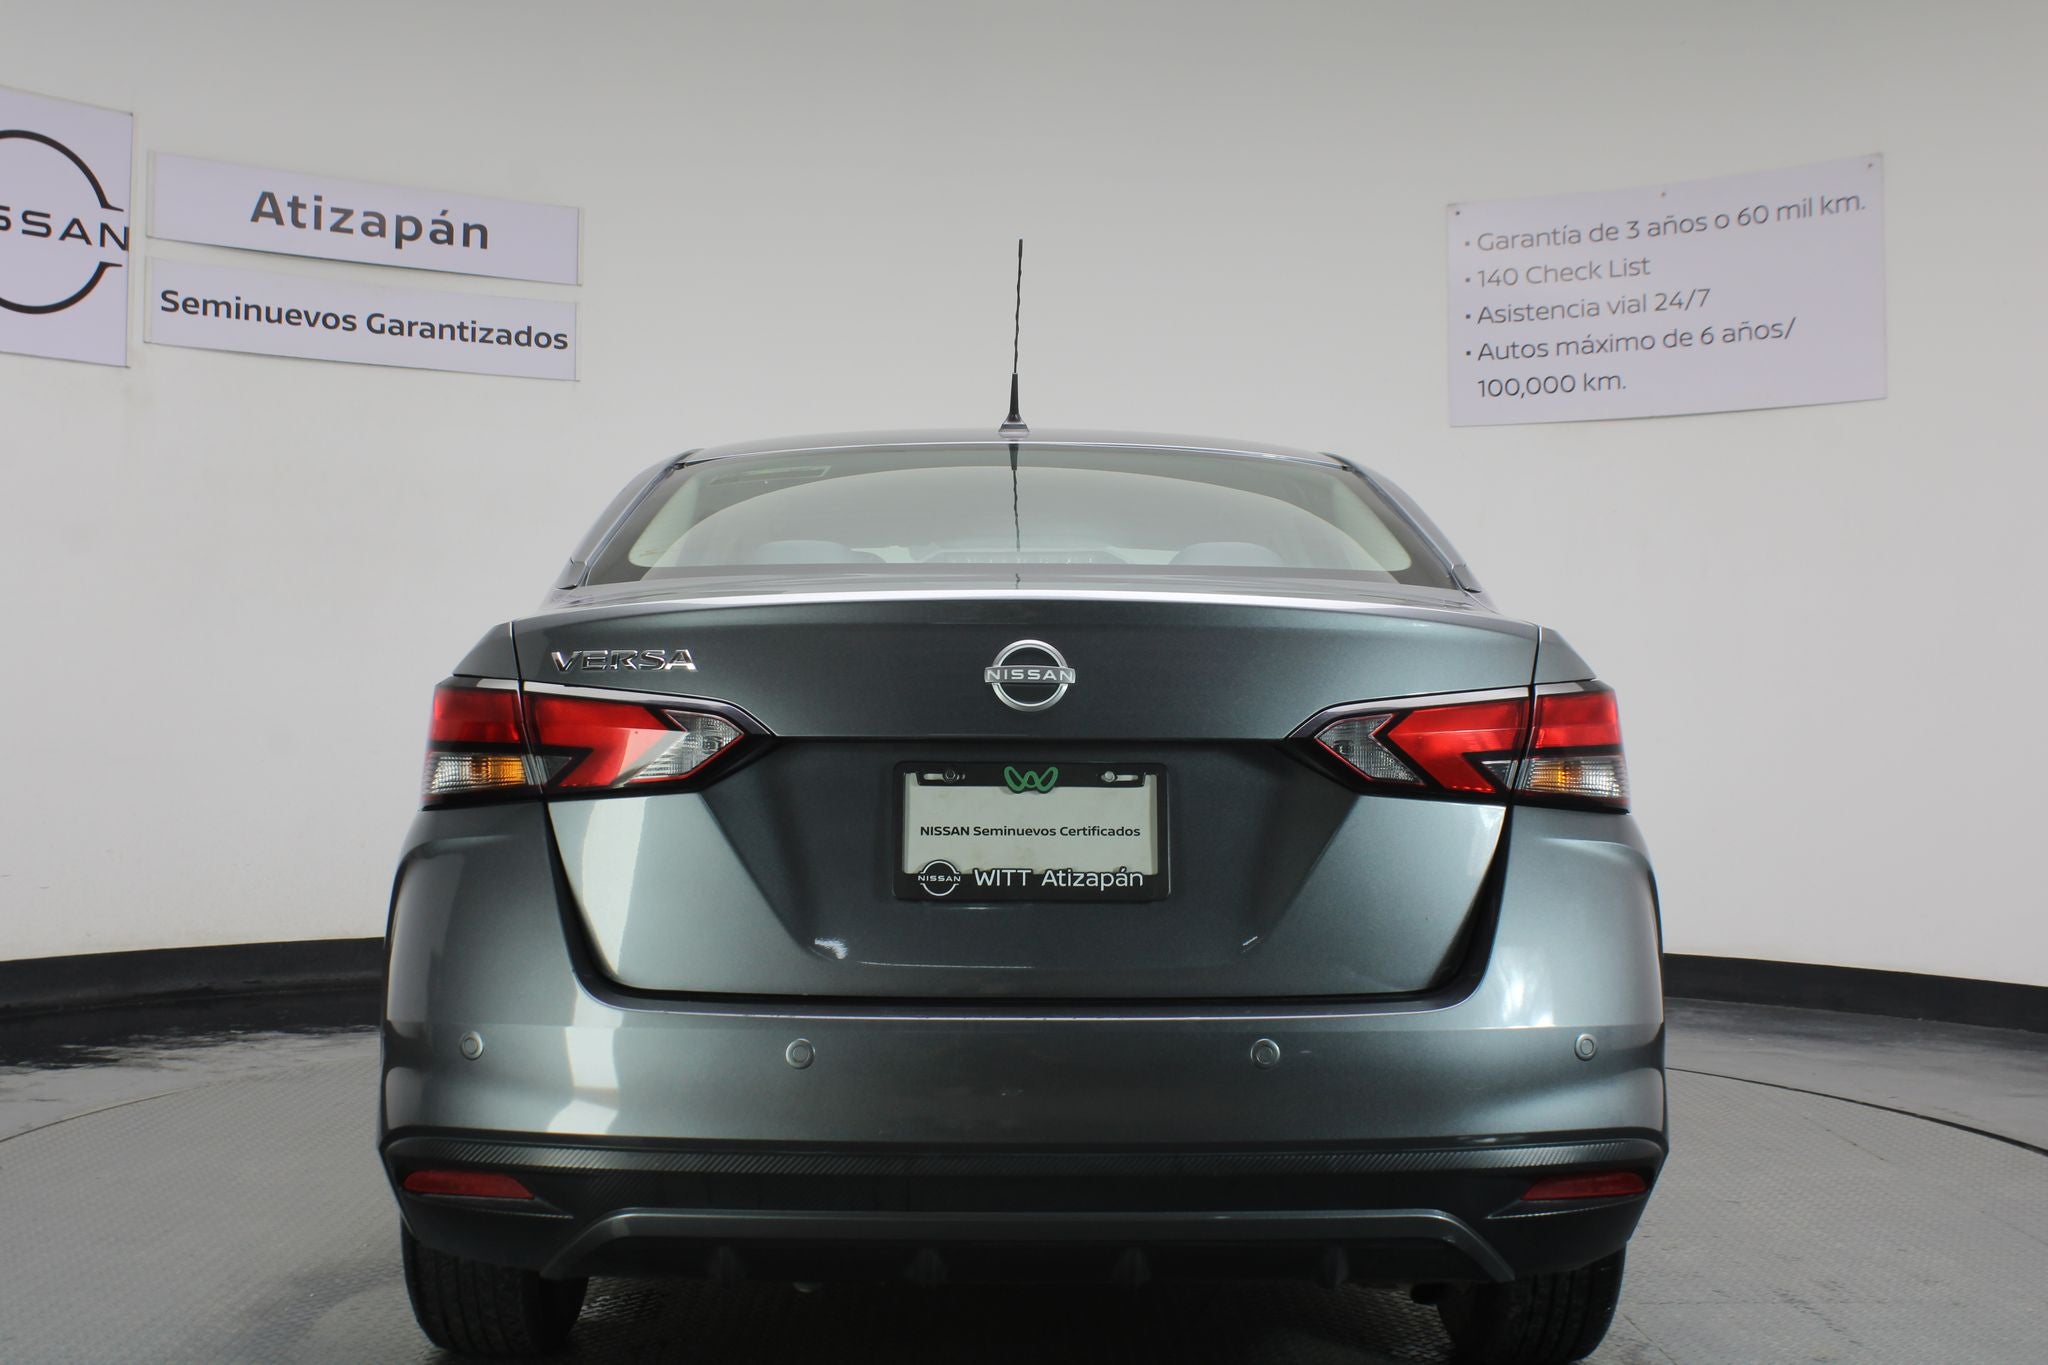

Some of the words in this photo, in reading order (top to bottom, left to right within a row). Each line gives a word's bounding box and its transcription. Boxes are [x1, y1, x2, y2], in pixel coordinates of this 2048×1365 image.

[250, 190, 489, 250] Atizapán
[1477, 224, 1582, 252] Garantía
[1588, 223, 1620, 243] de
[1625, 220, 1641, 240] 3
[1647, 214, 1708, 238] años
[1714, 213, 1730, 230] o
[1737, 204, 1770, 227] 60
[1775, 198, 1813, 221] mil
[1820, 193, 1867, 215] km.
[1477, 268, 1519, 288] 140
[1525, 260, 1602, 285] Check
[1608, 257, 1651, 278] List
[160, 289, 358, 332] Seminuevos
[366, 312, 569, 350] Garantizados
[1476, 299, 1600, 325] Asistencia
[1606, 293, 1647, 316] vial
[1654, 288, 1711, 312] 24/7
[1477, 341, 1549, 361] Autos
[1556, 333, 1656, 358] máximo
[1662, 328, 1693, 349] de
[1700, 326, 1715, 346] 6
[1722, 316, 1797, 344] años/
[1477, 374, 1576, 399] 100,000
[1583, 372, 1628, 392] km.
[551, 649, 699, 672] VERSA
[987, 669, 1073, 681] NISSAN
[920, 826, 970, 836] NISSAN
[973, 826, 1056, 837] Seminuevos
[1060, 825, 1141, 837] Certificados
[974, 869, 1032, 887] WITT
[1041, 866, 1144, 891] Atizapán
